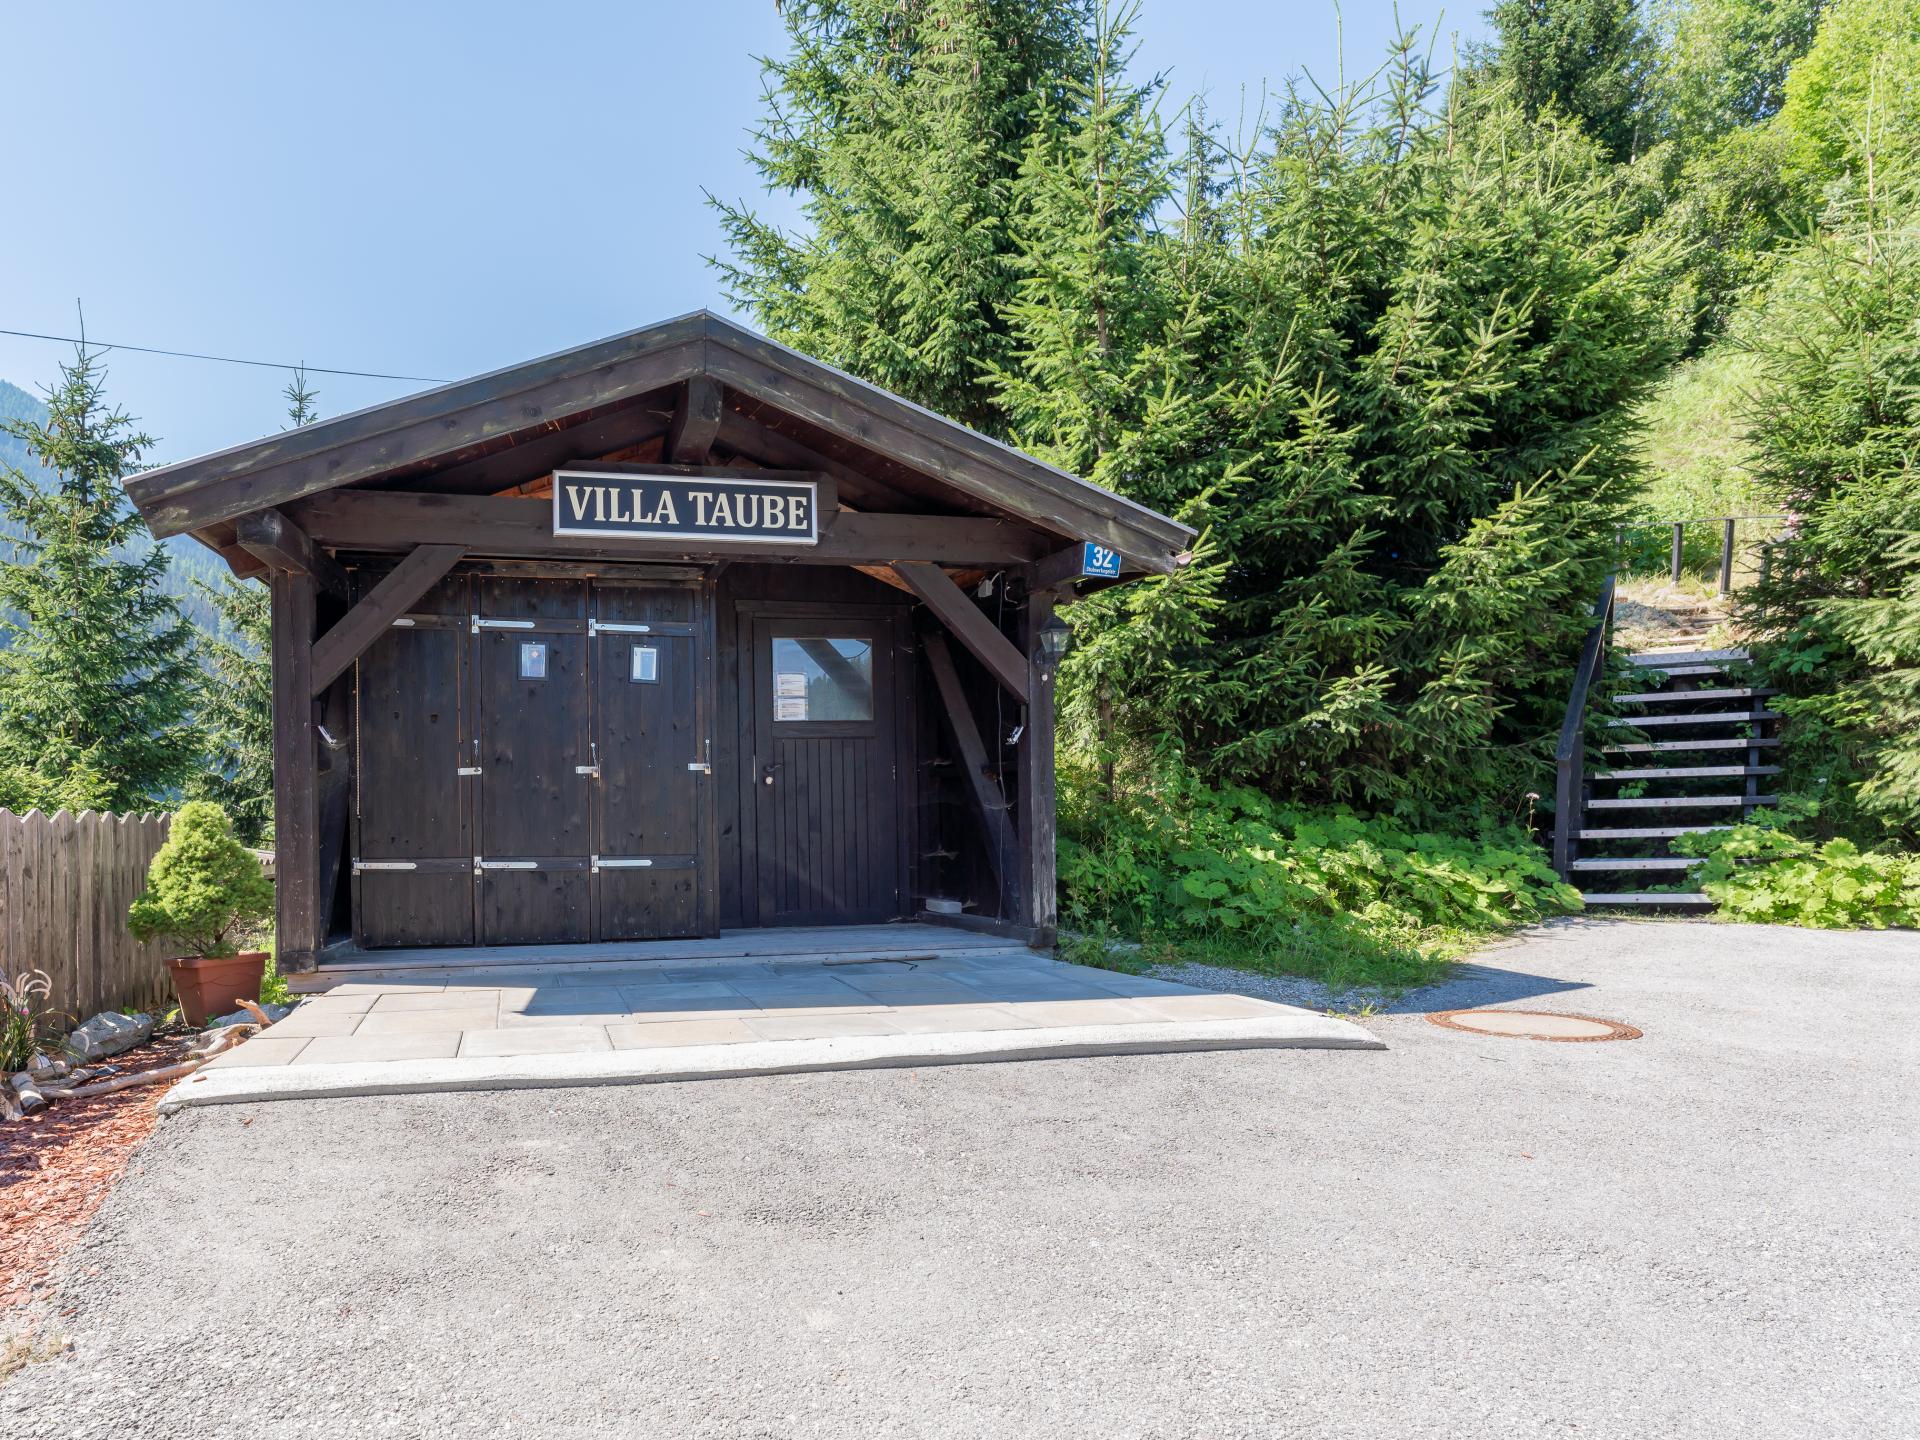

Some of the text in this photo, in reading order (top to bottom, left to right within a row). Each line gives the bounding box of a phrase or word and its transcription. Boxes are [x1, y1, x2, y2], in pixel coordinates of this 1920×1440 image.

[565, 485, 808, 530] VILLA TAUBE
[1093, 546, 1114, 568] 32
